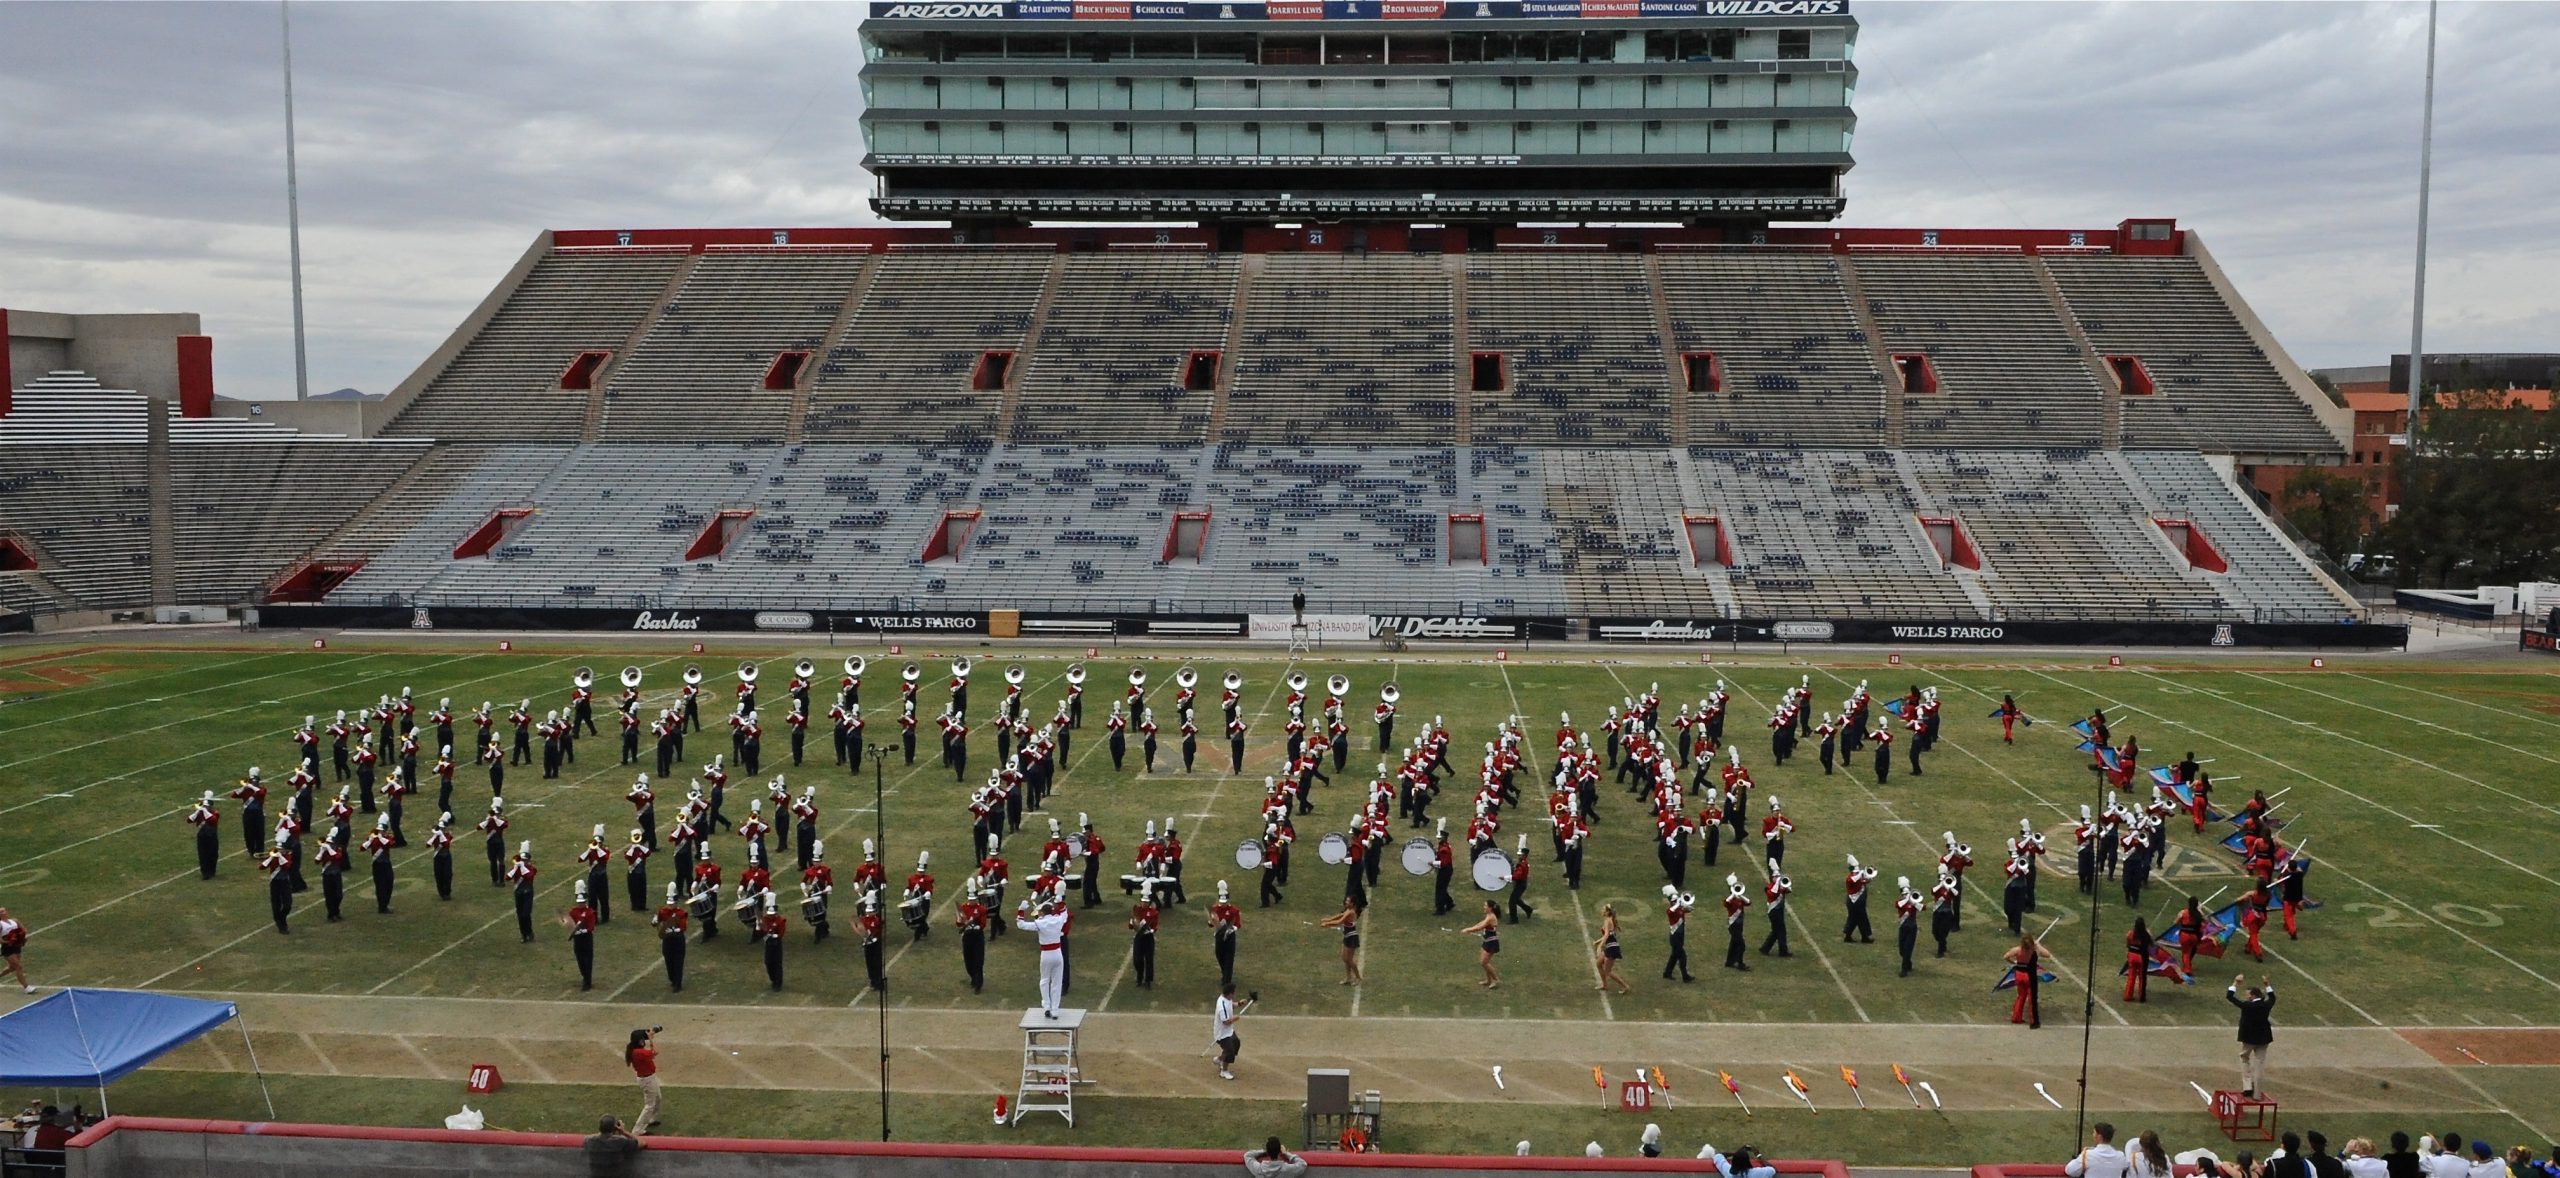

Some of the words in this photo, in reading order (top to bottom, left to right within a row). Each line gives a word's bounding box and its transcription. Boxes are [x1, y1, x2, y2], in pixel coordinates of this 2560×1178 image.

[883, 4, 1004, 18] ARIZONA
[1019, 5, 1028, 14] 22
[1028, 6, 1041, 14] ART
[1041, 6, 1071, 14] LUPPINO
[1084, 6, 1104, 14] RICKY
[1105, 6, 1130, 14] HUNLEY
[1136, 5, 1141, 14] 6
[1266, 6, 1272, 14] 4
[1272, 6, 1301, 15] DARRYLL
[1302, 6, 1323, 15] LEWIS
[1391, 6, 1405, 14] ROB
[1406, 6, 1439, 14] WALDROP
[1531, 5, 1547, 13] STEVE
[1588, 4, 1606, 12] CHRIS
[1607, 4, 1639, 12] McALISTER
[1646, 4, 1674, 12] ANTOINE
[1674, 4, 1697, 12] CASON
[1705, 0, 1840, 15] WILDCATS
[619, 237, 630, 246] 17
[775, 235, 786, 245] 18
[953, 235, 965, 244] 19
[1155, 235, 1169, 244] 20
[1310, 234, 1321, 244] 21
[1544, 235, 1556, 244] 22
[1752, 235, 1765, 245] 23
[1923, 237, 1936, 246] 24
[2070, 237, 2084, 247] 25
[251, 405, 261, 414] 16
[632, 610, 700, 630] Bashas'
[776, 616, 807, 624] CASINOS
[869, 617, 922, 628] WELLS
[925, 617, 977, 628] FARGO
[1252, 620, 1288, 632] UNIVERSITY
[1331, 622, 1351, 632] BAND
[1352, 622, 1366, 633] DAY
[1795, 626, 1828, 634] CASINOS
[1892, 626, 1947, 637] WELLS
[1950, 627, 2004, 638] FARGO
[470, 1068, 490, 1089] 40
[1626, 1086, 1645, 1107] 40
